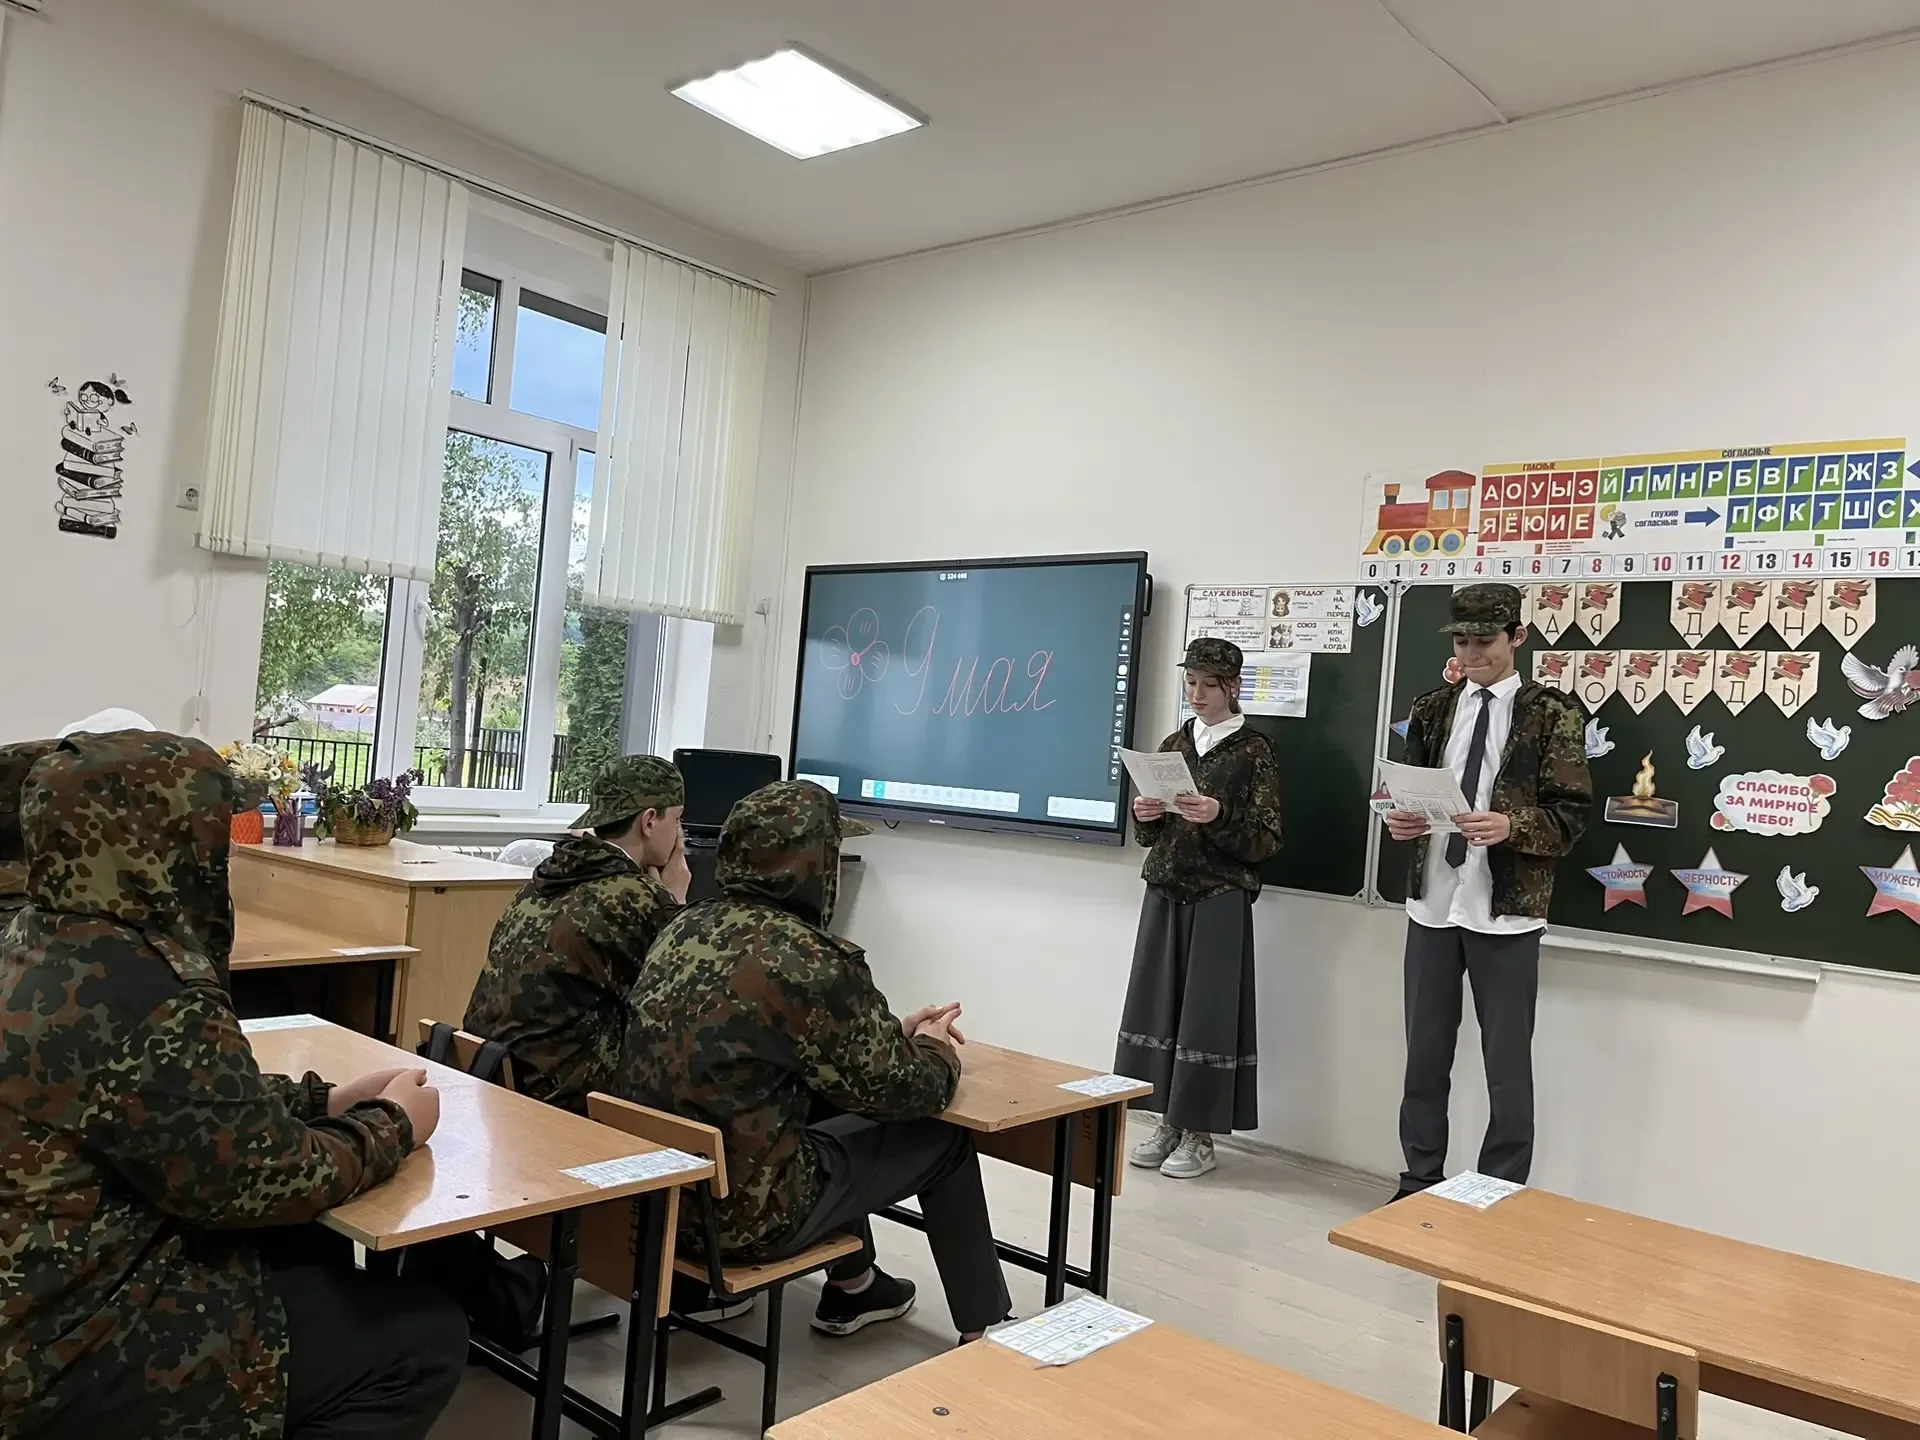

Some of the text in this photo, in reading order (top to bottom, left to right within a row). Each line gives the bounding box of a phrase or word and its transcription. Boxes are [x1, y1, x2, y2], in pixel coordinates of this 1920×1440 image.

[1722, 447, 1771, 459] СОГЛАСНЫЕ
[1522, 461, 1556, 471] ГЛАСНЫЕ
[1368, 563, 1377, 577] 0
[1393, 563, 1400, 576] 1
[1419, 563, 1429, 576] 2
[1446, 562, 1456, 575] 3
[1473, 561, 1483, 575] 4
[1502, 560, 1511, 574] 5
[1531, 559, 1541, 574] 6
[1561, 559, 1572, 573] 7
[1592, 558, 1602, 573] 8
[1624, 557, 1633, 572] 9
[1652, 556, 1672, 571] 10
[1686, 555, 1704, 570] 11
[1720, 554, 1741, 570] 12
[1756, 553, 1777, 569] 13
[1792, 552, 1813, 568] 14
[1830, 551, 1851, 568] 15
[1868, 551, 1890, 567] 16
[1202, 589, 1255, 597] СЛУЖЕБНЫЕ
[1545, 613, 1602, 636] АЯ
[895, 605, 940, 715] 9
[932, 650, 1057, 717] мая
[1545, 680, 1800, 707] ОБЕДЫ
[1736, 780, 1810, 797] СПАСИБО
[1725, 795, 1818, 814] ЗА МИРНОЕ
[1746, 812, 1794, 827] НЕБО!
[1600, 866, 1648, 881] СТОЙКОСТЬ
[1684, 871, 1740, 888] ВЕРНОСТЬ
